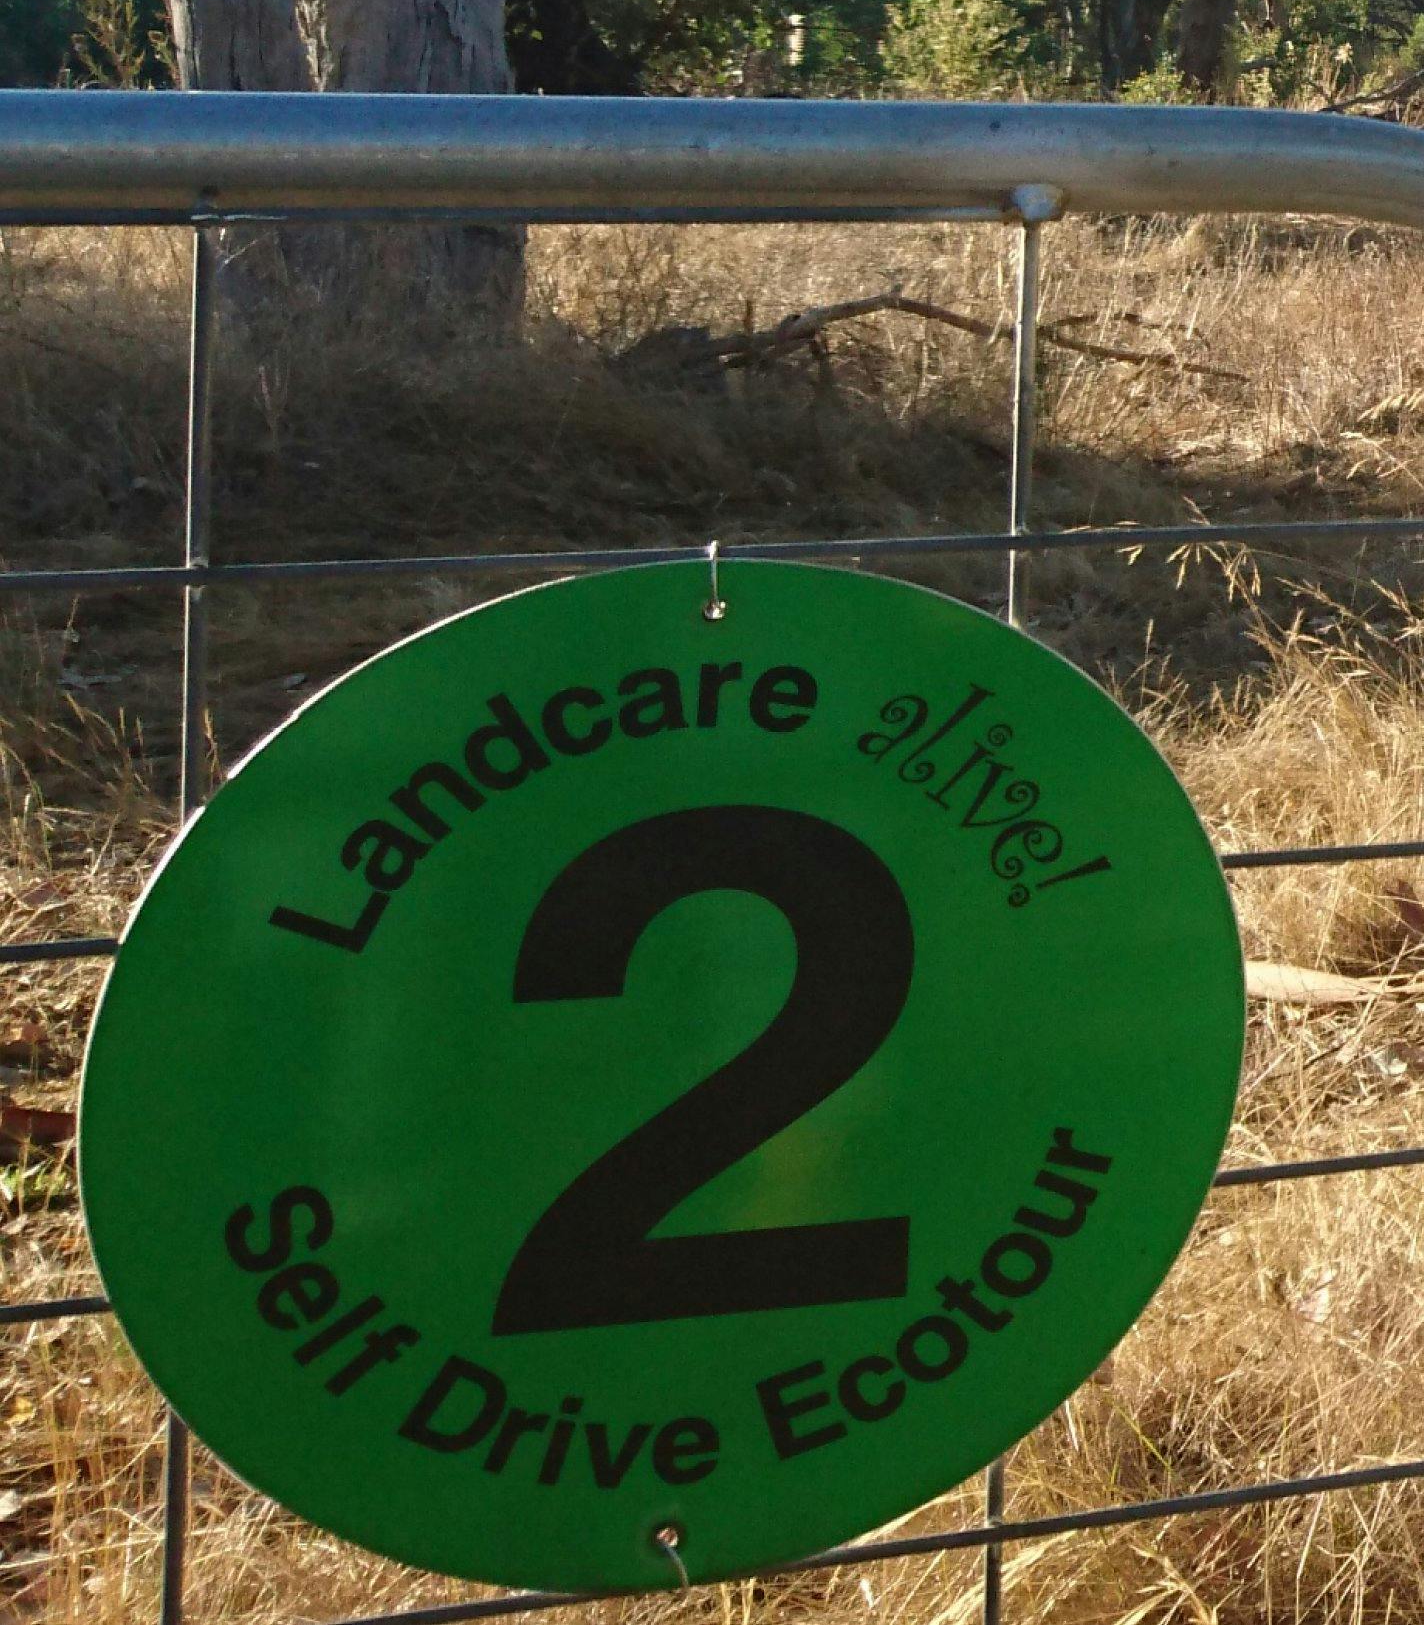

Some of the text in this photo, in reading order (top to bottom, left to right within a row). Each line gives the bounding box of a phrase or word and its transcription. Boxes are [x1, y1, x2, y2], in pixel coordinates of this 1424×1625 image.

[271, 662, 1111, 954] Landcare alive!
[491, 804, 915, 1337] 2
[223, 1127, 1112, 1492] Self Drive Ecotour
